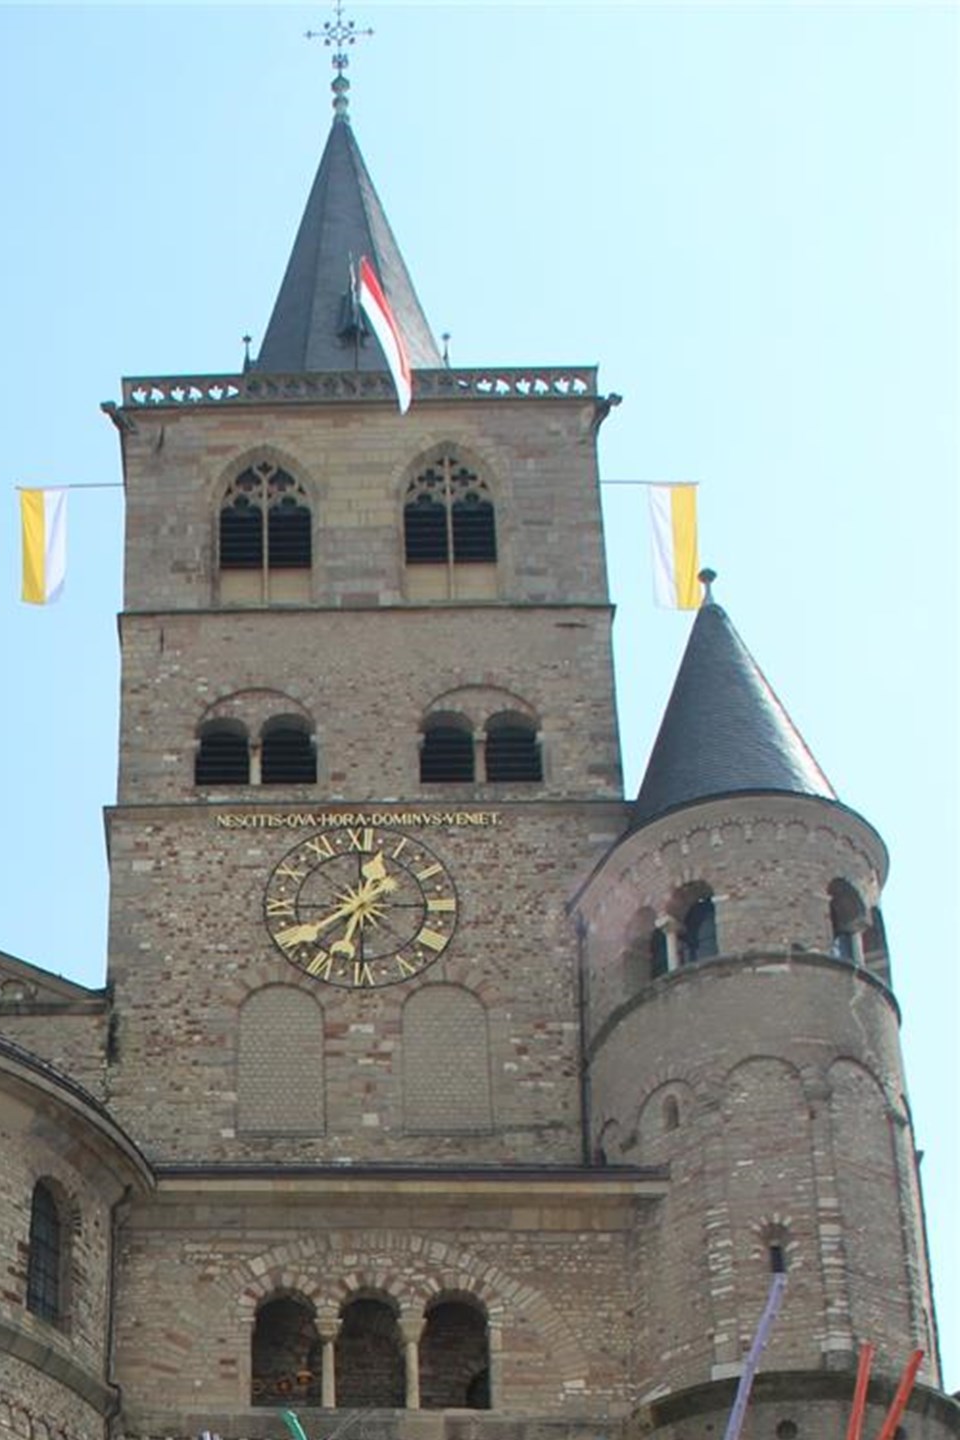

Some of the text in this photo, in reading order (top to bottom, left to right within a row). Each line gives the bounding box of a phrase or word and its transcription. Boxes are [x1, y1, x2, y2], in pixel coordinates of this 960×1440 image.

[321, 813, 368, 826] HORA
[371, 813, 441, 826] DOMINVS
[347, 828, 374, 851] XII
